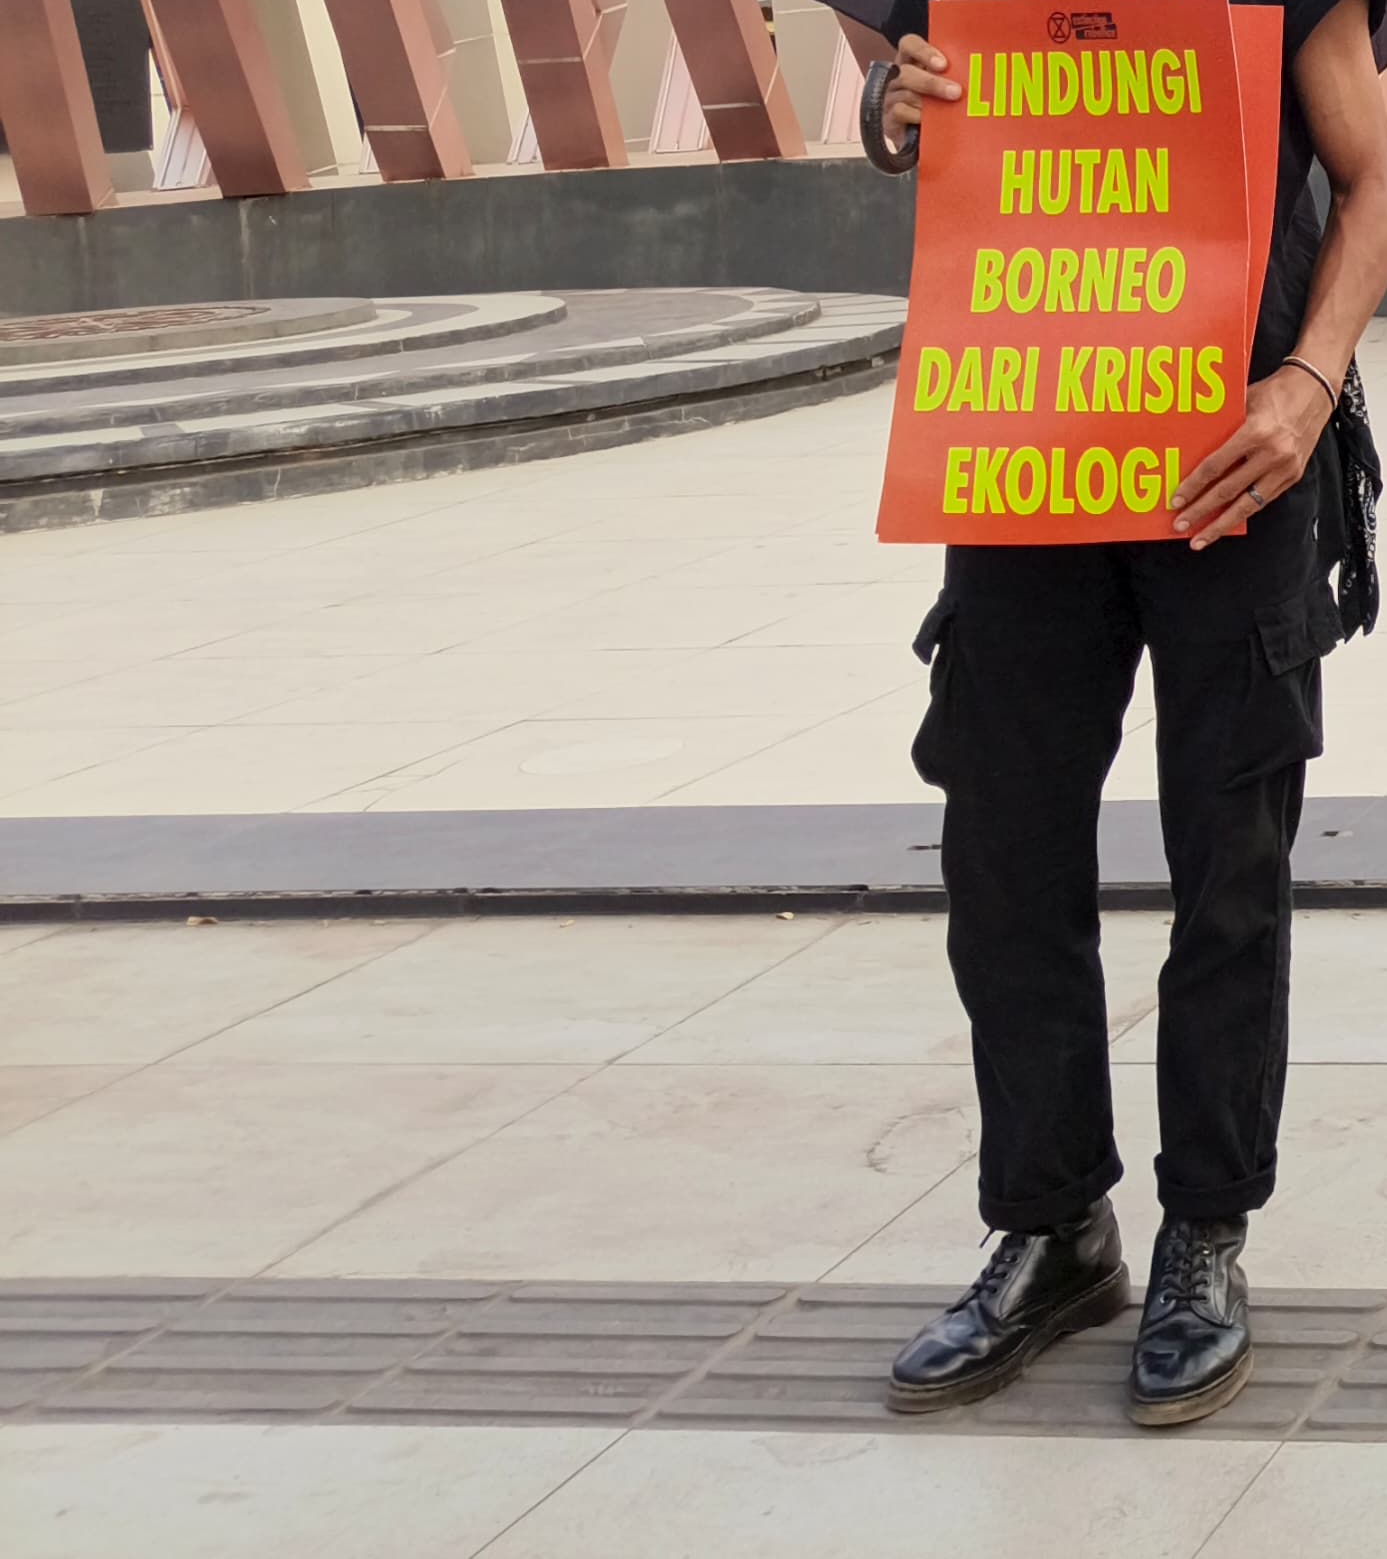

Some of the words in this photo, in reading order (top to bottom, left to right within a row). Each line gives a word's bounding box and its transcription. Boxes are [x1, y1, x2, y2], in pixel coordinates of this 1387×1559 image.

[966, 48, 1202, 117] LINDUNGI
[999, 147, 1169, 215] HUTAN
[970, 246, 1187, 314] BORNEO
[913, 346, 1041, 412] DARI
[1055, 345, 1226, 414] KRISIS
[942, 445, 1180, 514] EKOLOGI
